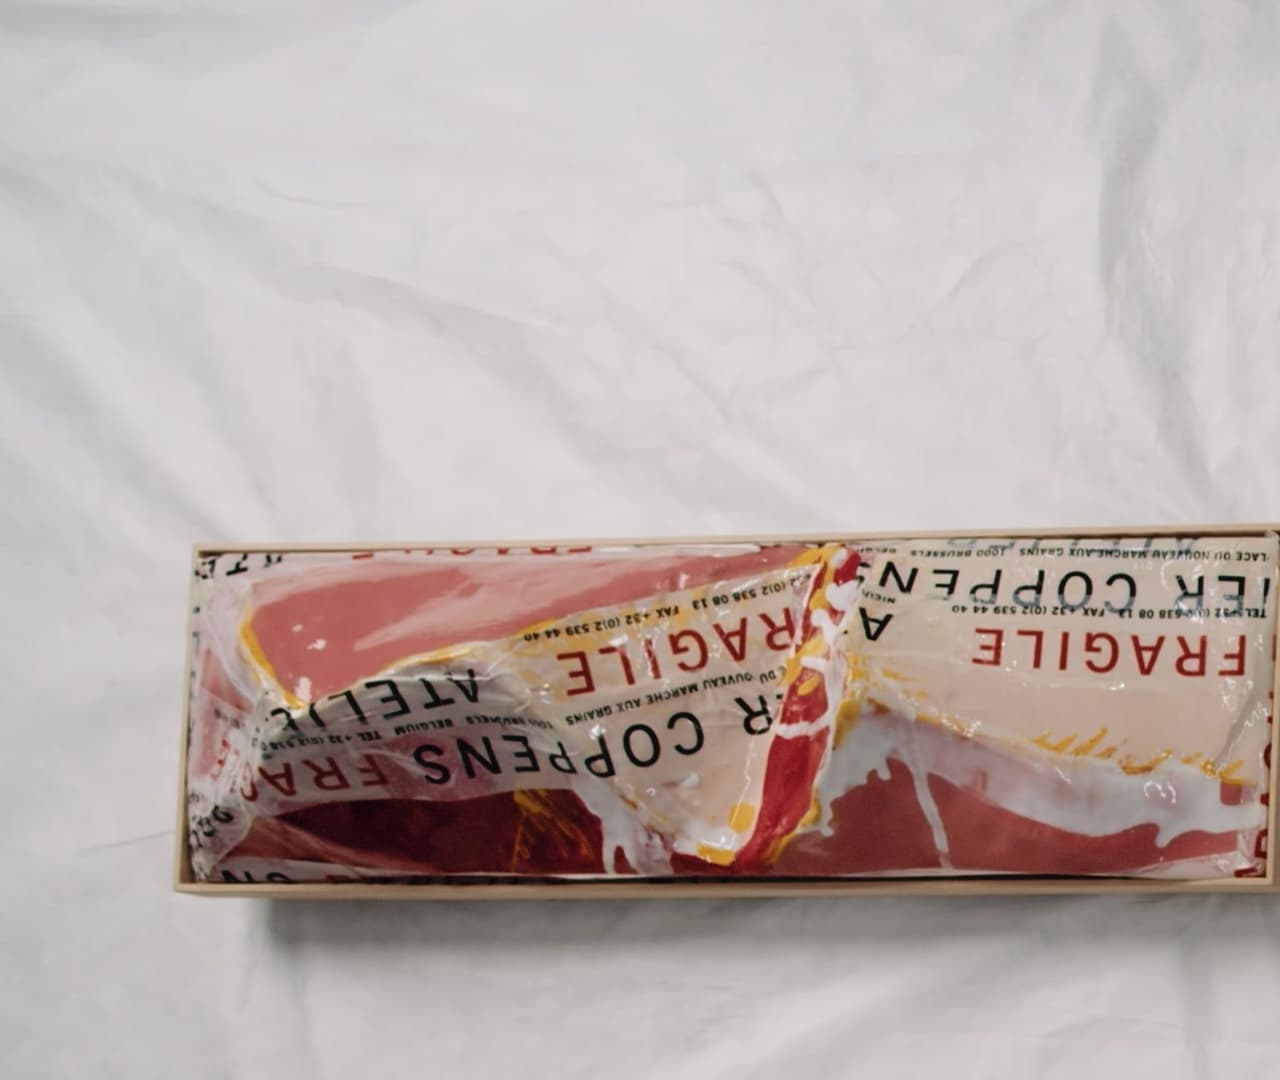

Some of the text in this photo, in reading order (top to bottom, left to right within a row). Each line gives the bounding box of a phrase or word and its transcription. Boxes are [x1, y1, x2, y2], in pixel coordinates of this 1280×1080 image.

[909, 550, 972, 558] BRUSSELS
[1020, 548, 1064, 557] GRAINS
[732, 588, 756, 601] 538
[762, 582, 786, 595] (0)2
[692, 598, 708, 610] 13
[712, 594, 728, 605] 08
[655, 605, 679, 618] FAX
[952, 605, 968, 613] 40
[972, 606, 989, 614] 44
[994, 606, 1016, 615] 539
[1022, 604, 1046, 615] (0)2
[1082, 608, 1105, 618] FAX
[1138, 609, 1154, 618] 08
[565, 623, 590, 636] 539
[594, 616, 620, 631] (0)2
[544, 628, 561, 638] 44
[556, 608, 796, 696] RAGILE
[971, 628, 1246, 677] FRAGILE
[702, 672, 752, 689] OUVEAU
[646, 684, 698, 704] MARCHE
[616, 697, 640, 712] AUX
[566, 706, 612, 726] GRAINS
[394, 718, 453, 736] BELGIUM
[328, 735, 352, 744] +32
[356, 730, 382, 742] TEL
[413, 712, 704, 784] COPPENS
